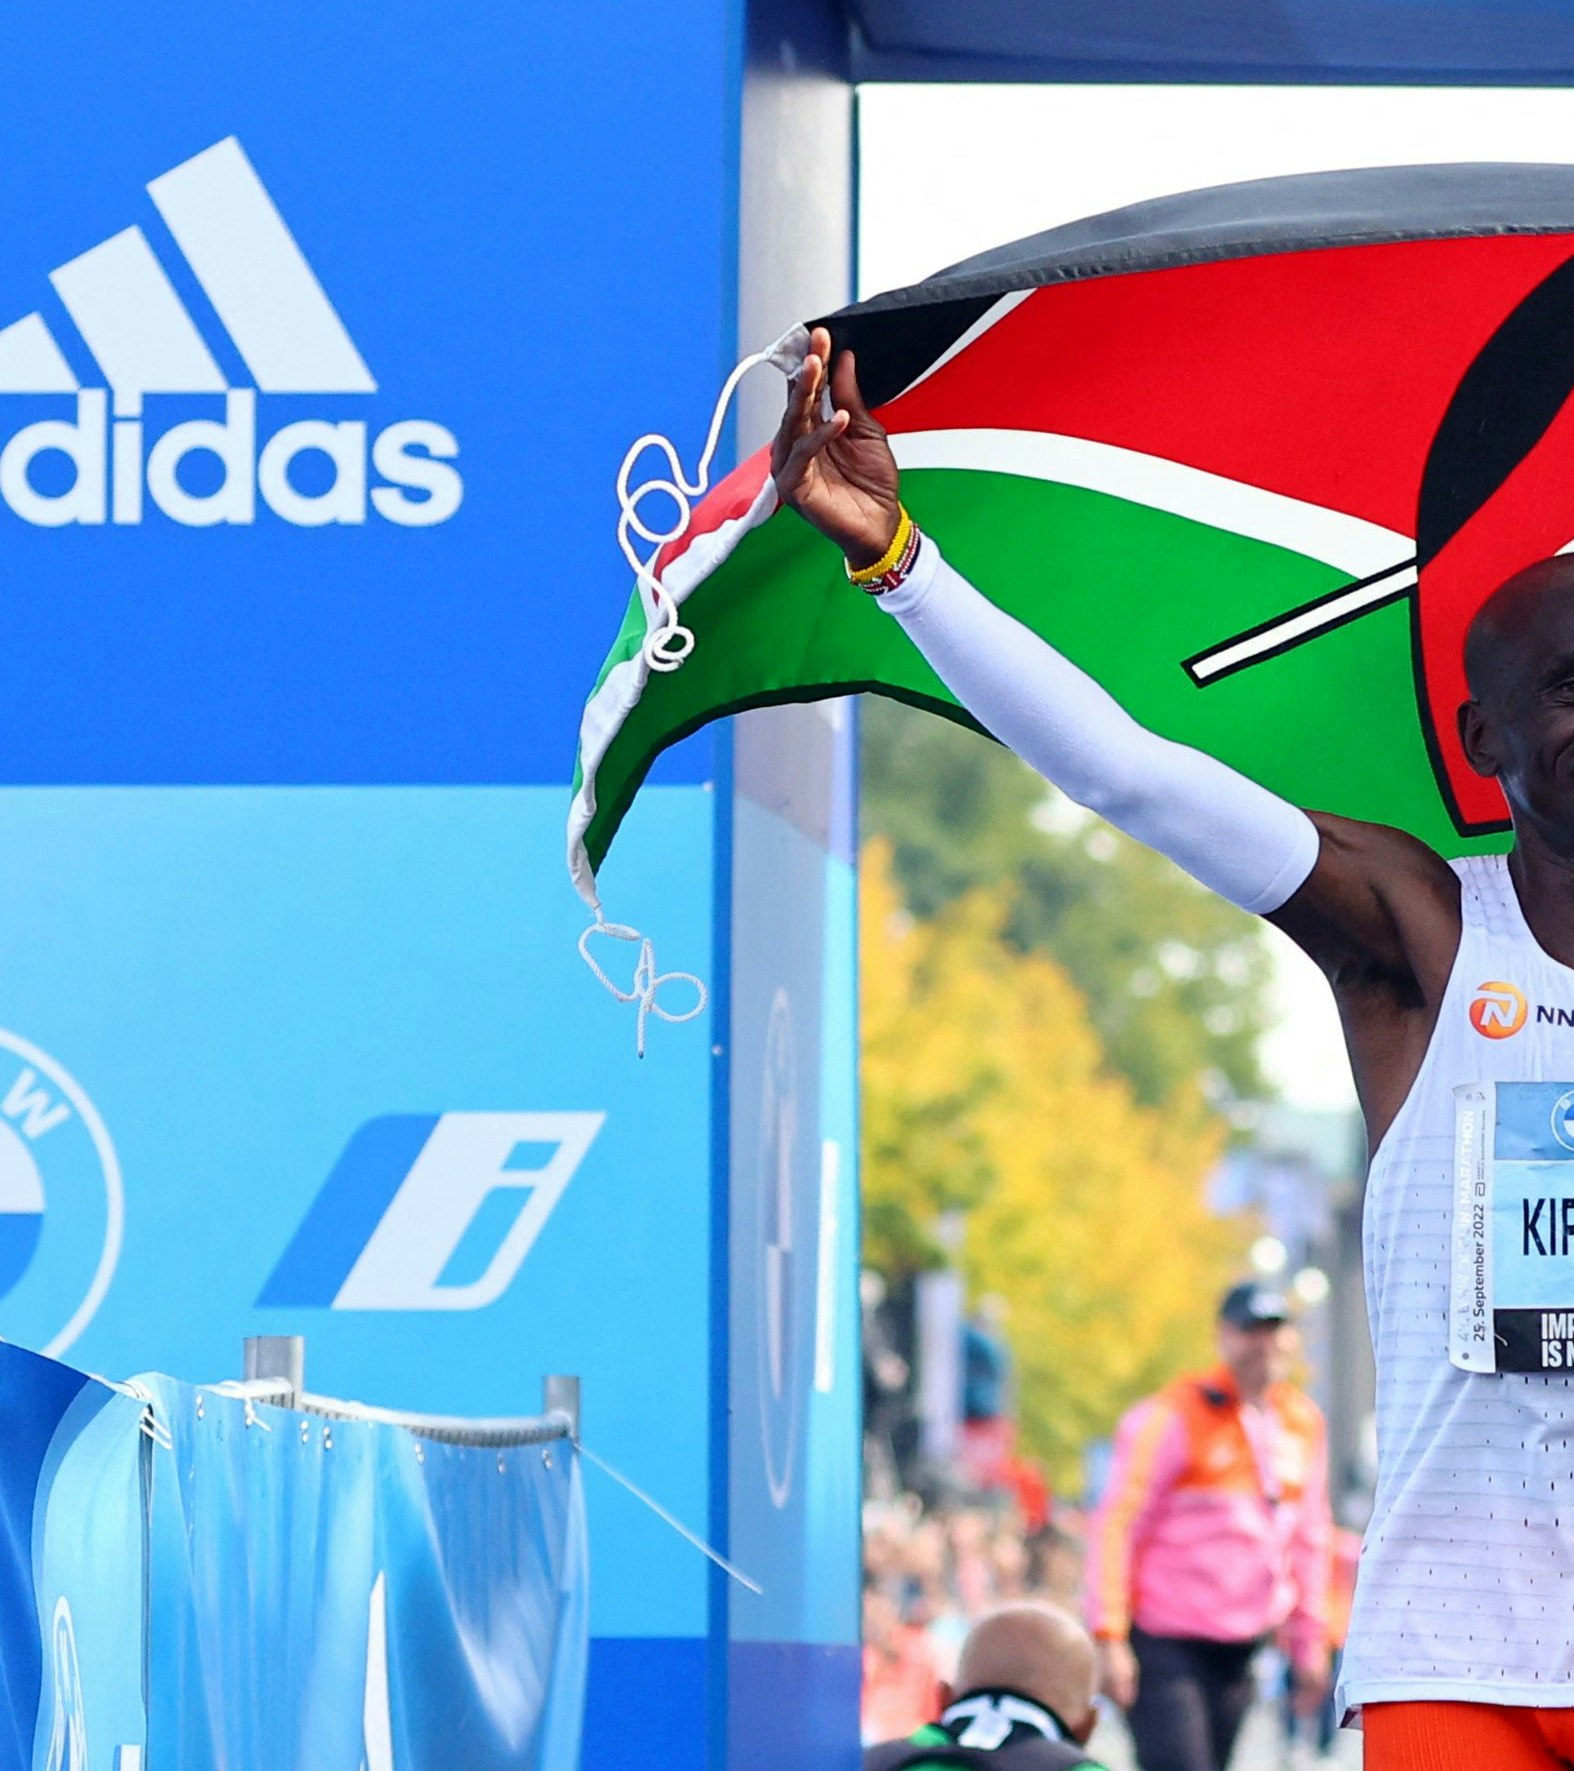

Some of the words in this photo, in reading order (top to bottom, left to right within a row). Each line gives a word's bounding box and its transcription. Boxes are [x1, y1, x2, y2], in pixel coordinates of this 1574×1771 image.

[0, 388, 463, 527] didas
[1473, 1204, 1484, 1239] 2022
[1473, 1242, 1486, 1317] September
[1542, 1340, 1563, 1367] IS
